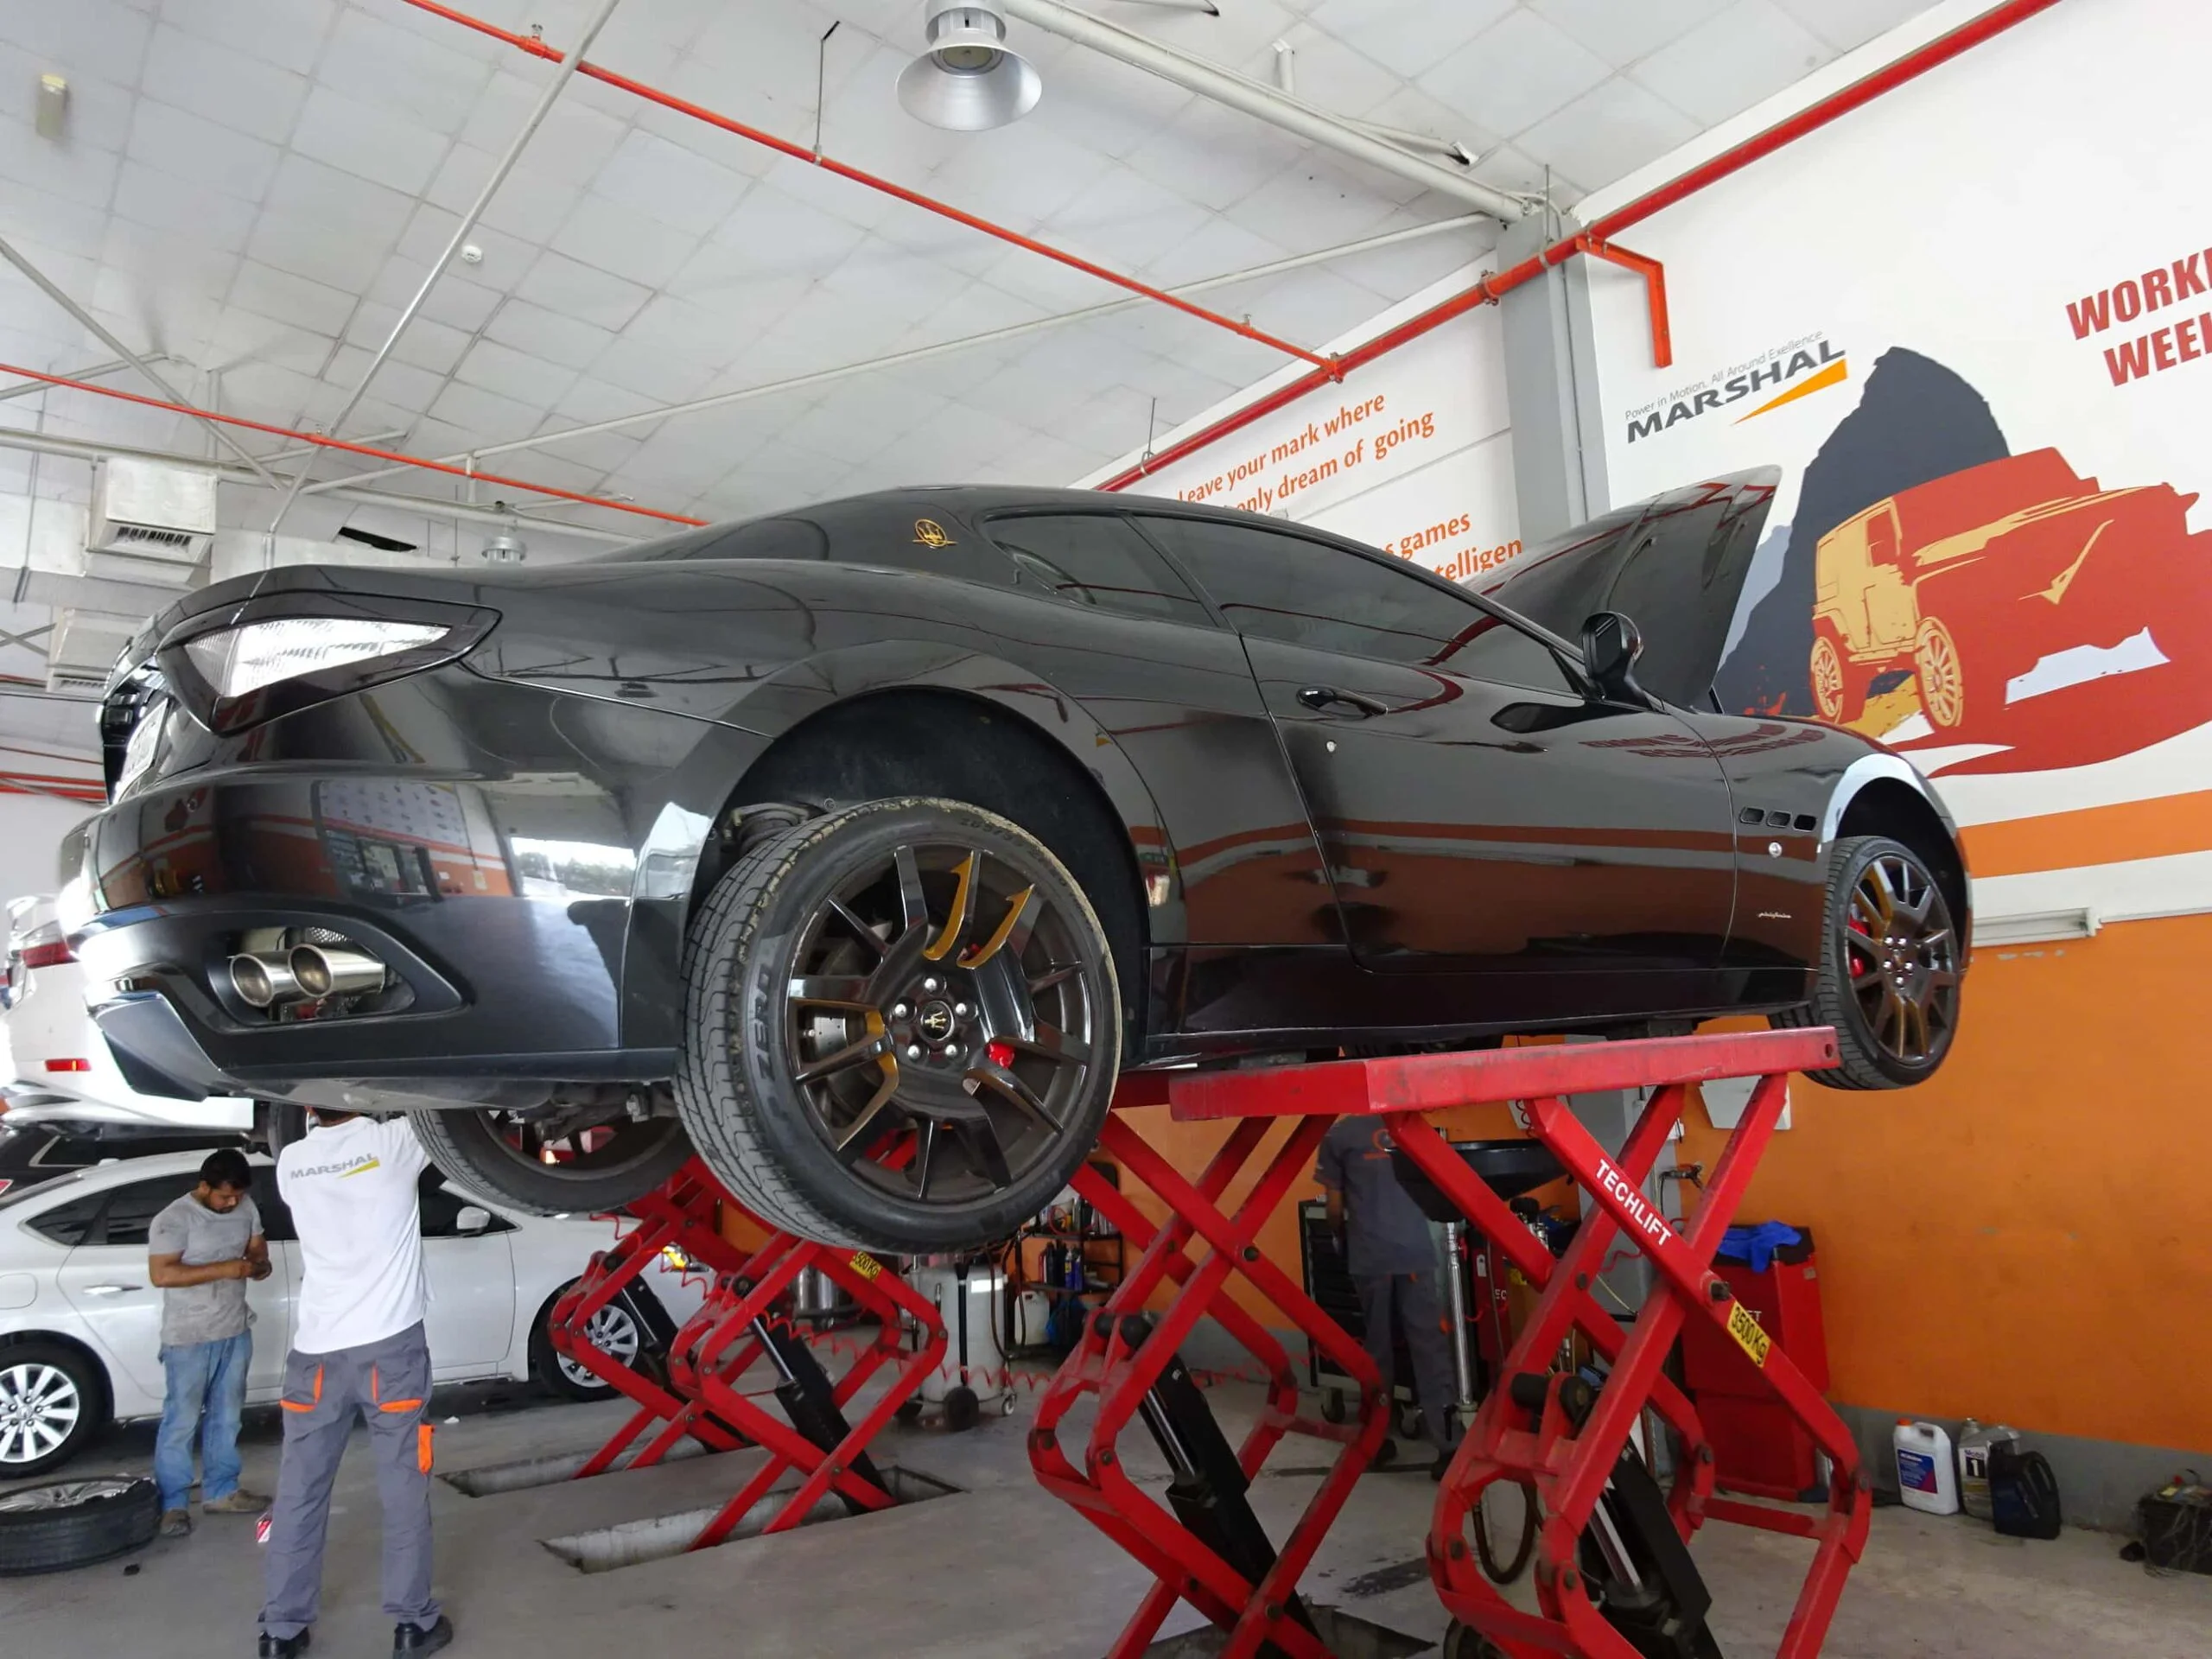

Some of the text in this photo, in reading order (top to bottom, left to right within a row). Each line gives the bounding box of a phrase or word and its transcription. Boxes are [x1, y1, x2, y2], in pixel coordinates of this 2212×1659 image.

[1625, 402, 1654, 420] Power
[1657, 397, 1668, 408] in
[1711, 370, 1724, 384] All
[1727, 353, 1766, 377] Around
[1628, 340, 1847, 444] MARSHAL
[1227, 454, 1267, 492] your
[1271, 423, 1320, 464] mark
[1325, 394, 1384, 437] where
[1278, 459, 1338, 499] dream
[1344, 438, 1364, 467] of
[1375, 412, 1434, 461] going
[1401, 513, 1471, 561] games
[1435, 539, 1522, 582] telligen
[290, 1153, 373, 1179] MARSHAL
[1595, 1160, 1672, 1246] TECHLIFT
